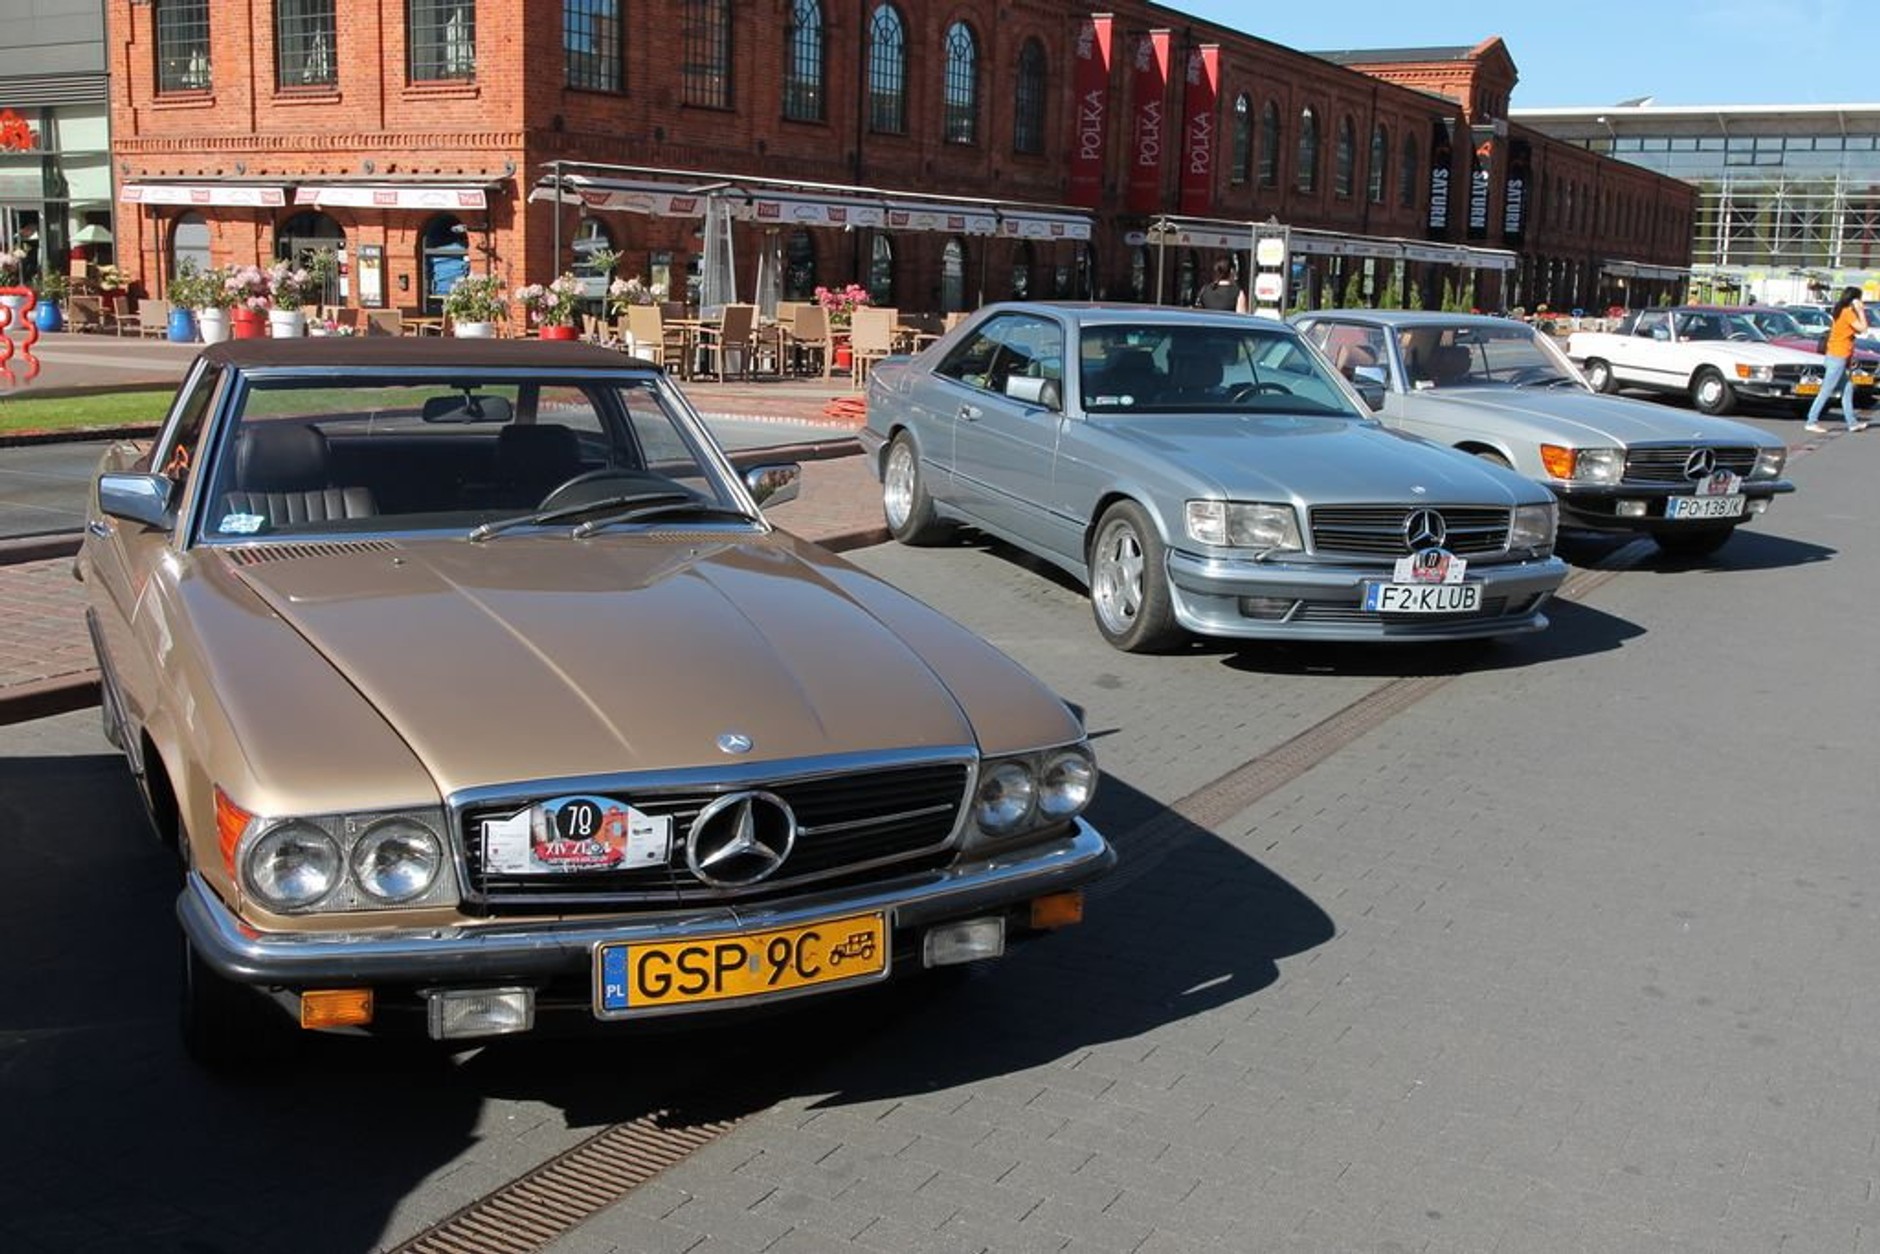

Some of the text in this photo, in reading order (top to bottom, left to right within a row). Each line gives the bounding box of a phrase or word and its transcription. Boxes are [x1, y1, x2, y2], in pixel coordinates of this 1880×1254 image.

[1081, 90, 1104, 159] POLKA
[1140, 101, 1162, 165] POLKA
[1191, 112, 1211, 174] POLKA
[1430, 168, 1449, 227] SATURN
[1470, 170, 1489, 227] SATURN
[1505, 179, 1523, 232] SATURN
[1677, 500, 1700, 516] PO
[1381, 587, 1476, 610] F2 KLUB
[606, 984, 625, 998] PL
[637, 931, 821, 998] GSP 9C
